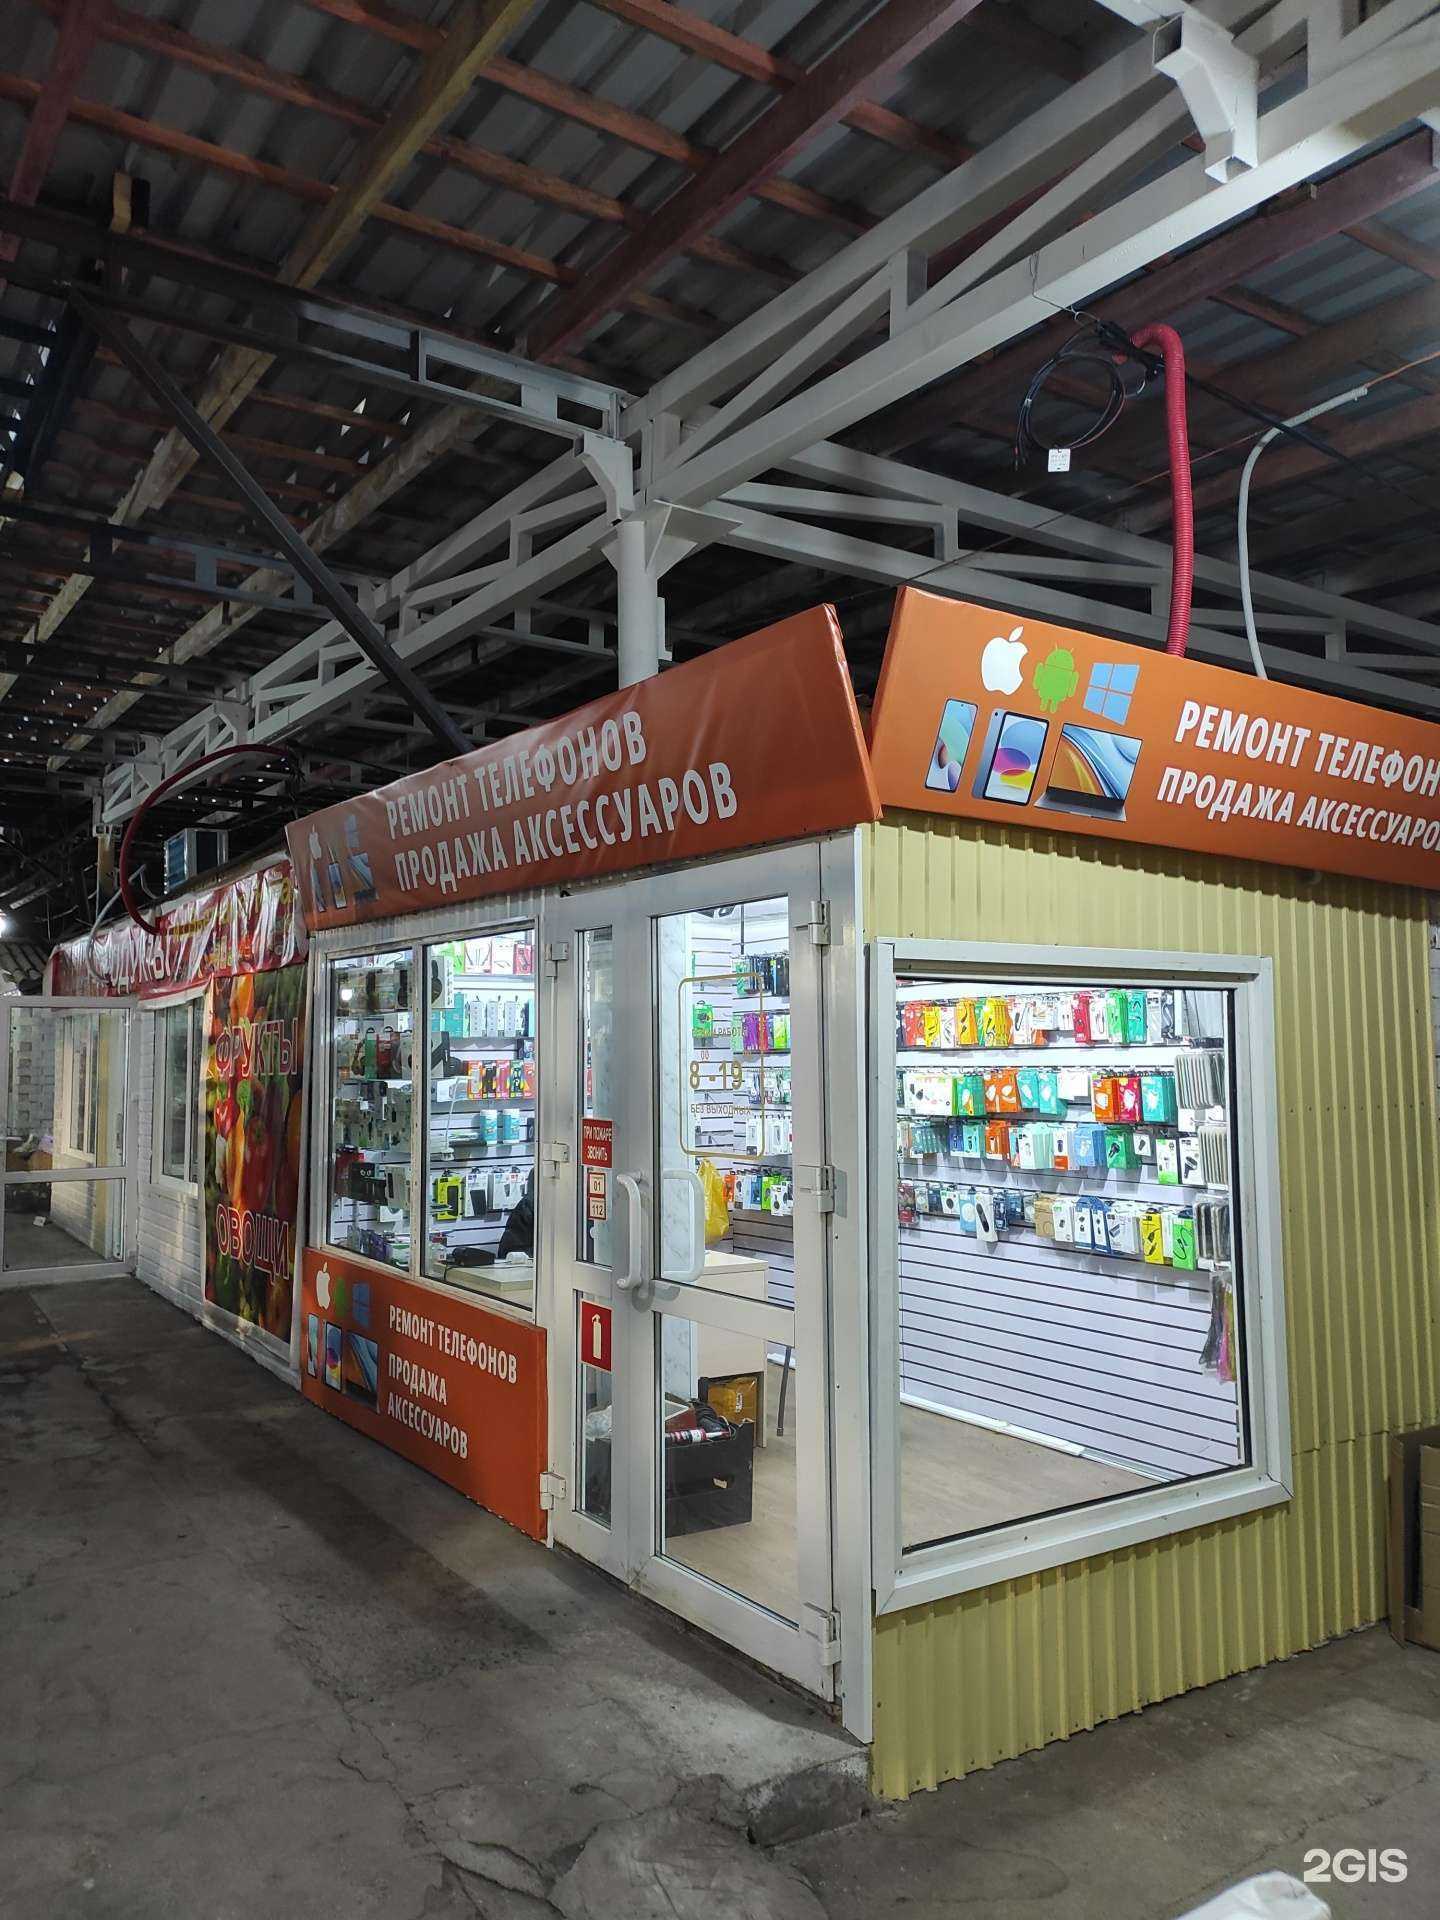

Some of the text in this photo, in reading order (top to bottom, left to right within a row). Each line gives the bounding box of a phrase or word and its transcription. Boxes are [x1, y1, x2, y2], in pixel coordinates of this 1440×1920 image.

[1174, 699, 1312, 768] РЕМОНТ
[385, 711, 647, 840] РЕМОНТ ТЕЛЕФОНОВ
[394, 762, 738, 895] ПРОДАЖА АКСЕССУАРОВ
[1156, 766, 1440, 851] ПРОДАЖА АКСЕССУАРО
[215, 1017, 298, 1077] ФРУКТЫ
[583, 1125, 612, 1142] ПРИ ПОЖАРЕ
[690, 1103, 752, 1116] БЕЗ ВЫХОДНЫХ
[587, 1145, 608, 1161] ЗВОНИТЬ
[592, 1204, 603, 1216] 112
[593, 1180, 601, 1192] 01
[216, 1203, 289, 1286] ОВОЩИ
[389, 1304, 517, 1384] РЕМОНТ ТЕЛЕФОНОВ
[388, 1353, 447, 1406] ПРОДАЖА
[387, 1392, 468, 1459] АКСЕССУАРОВ
